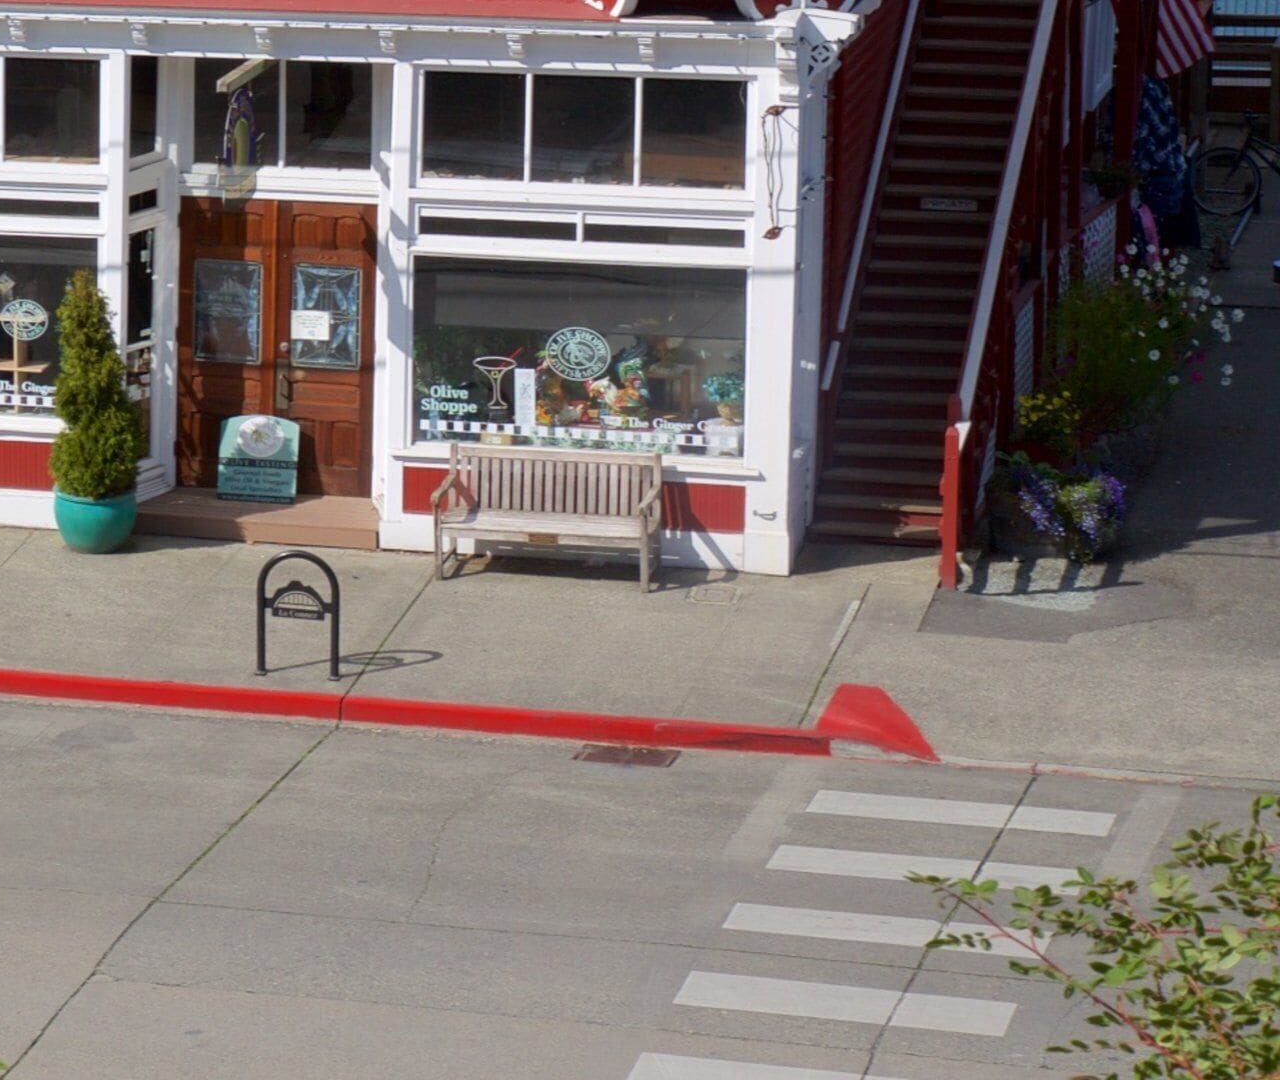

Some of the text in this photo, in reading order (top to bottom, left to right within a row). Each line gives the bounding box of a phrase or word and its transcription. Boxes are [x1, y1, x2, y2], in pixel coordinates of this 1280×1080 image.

[21, 381, 57, 396] Ginge
[430, 385, 469, 400] Olive
[421, 398, 478, 414] Shoppe
[628, 416, 649, 428] The
[652, 417, 694, 432] Ginger
